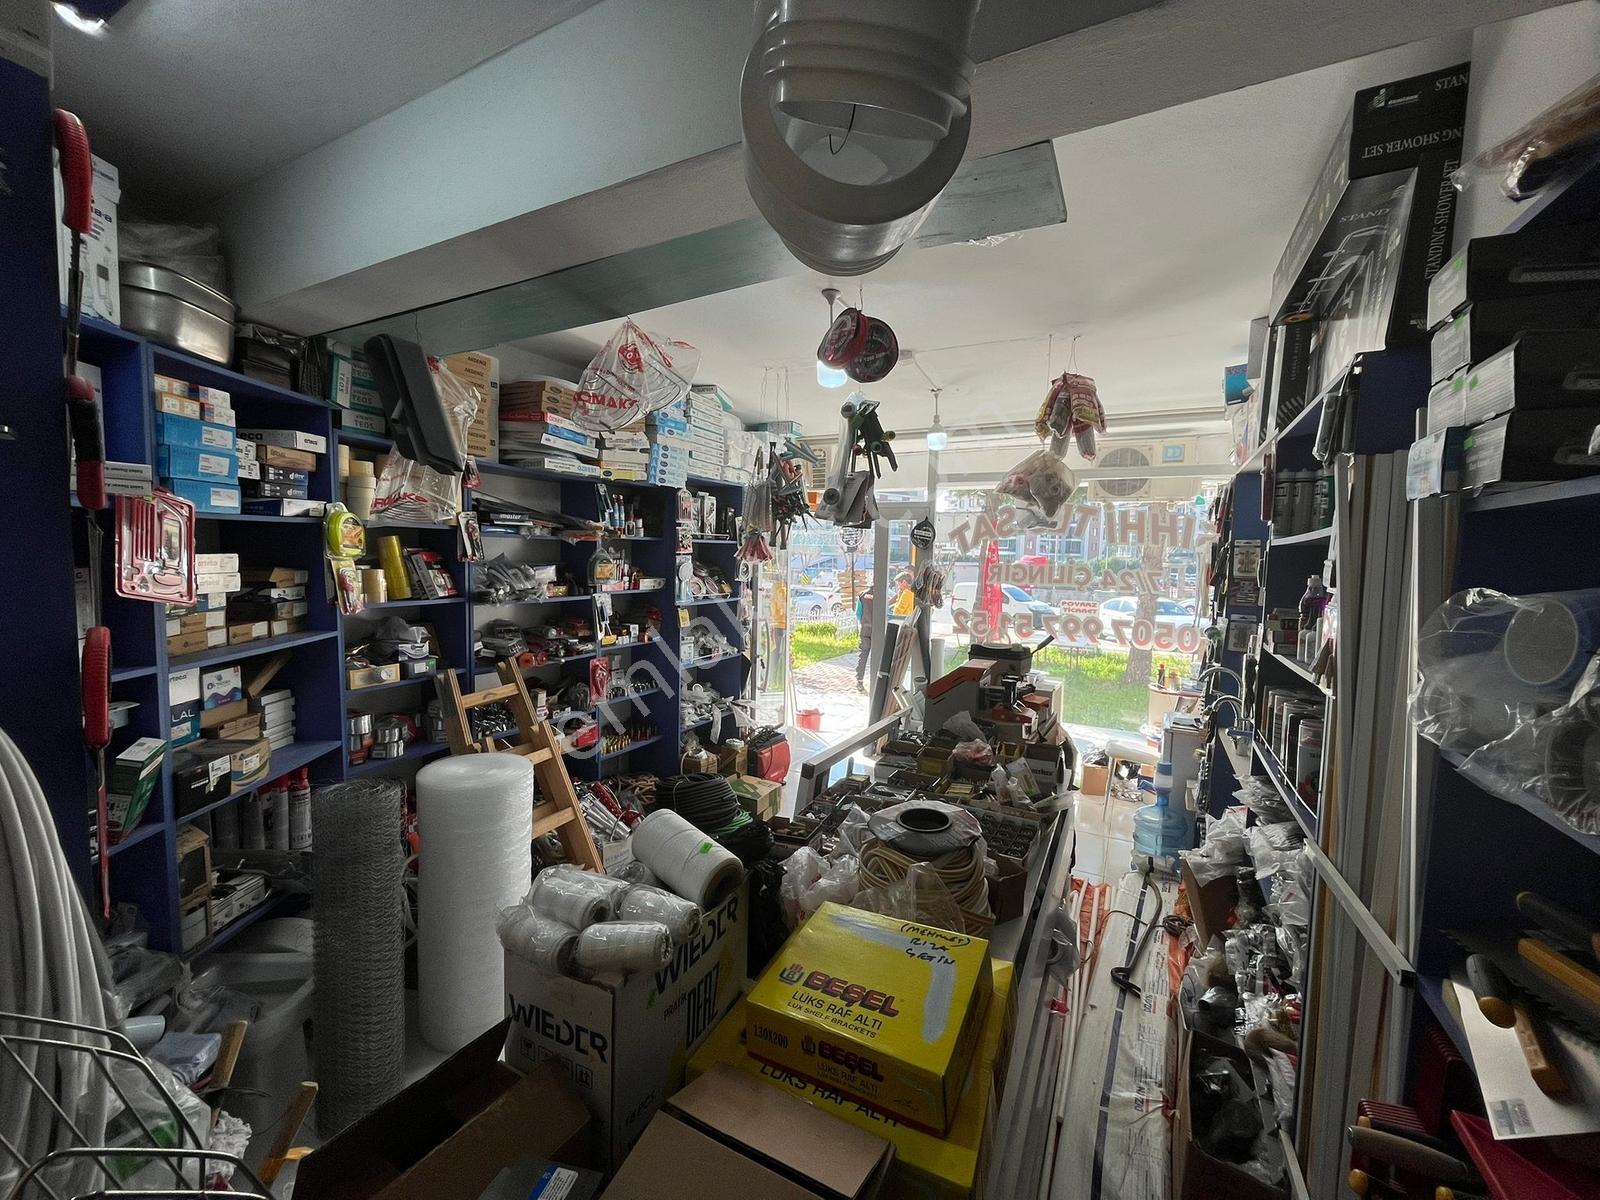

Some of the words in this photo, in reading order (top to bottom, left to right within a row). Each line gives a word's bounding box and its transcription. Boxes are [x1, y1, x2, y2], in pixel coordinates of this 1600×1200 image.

[1361, 143, 1385, 159] SET
[1386, 131, 1440, 153] SHOWER
[1435, 178, 1454, 224] SHOWER
[1424, 226, 1447, 280] STANDING
[786, 1001, 804, 1014] LUX
[804, 1007, 831, 1023] SHELF
[831, 1018, 877, 1040] BRACKETS
[827, 1003, 854, 1021] RAF
[855, 1012, 883, 1031] ALTI
